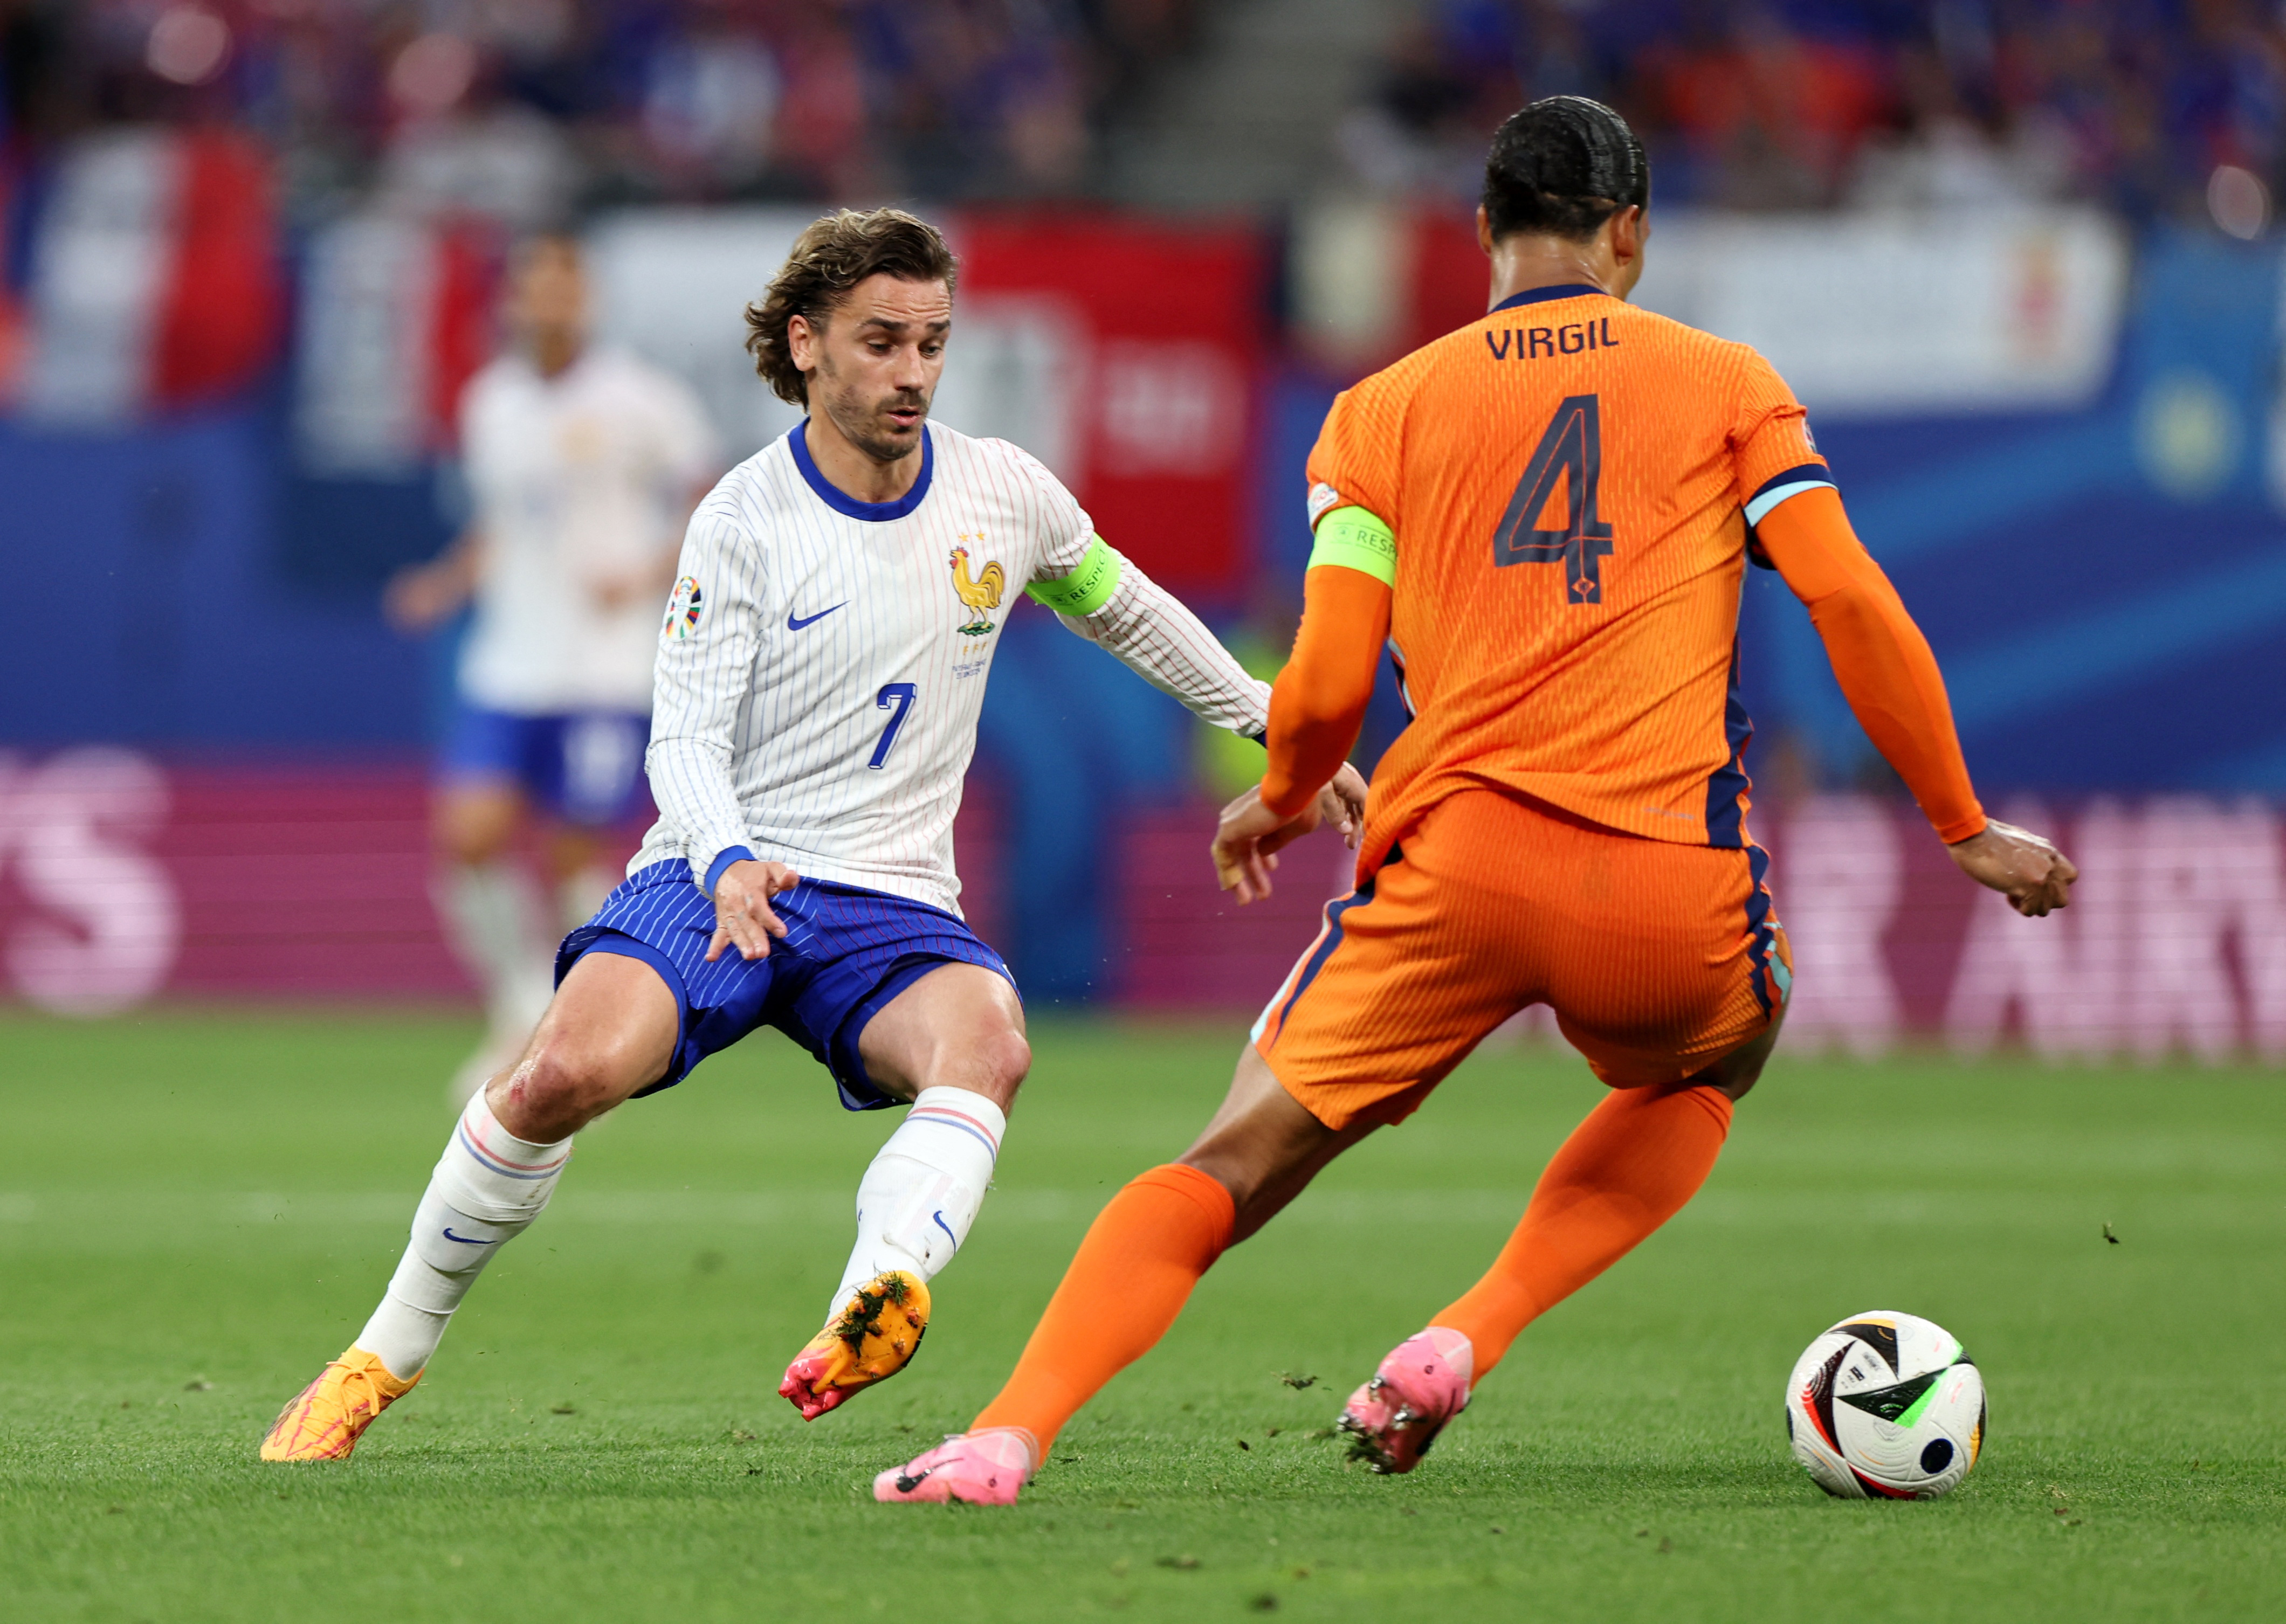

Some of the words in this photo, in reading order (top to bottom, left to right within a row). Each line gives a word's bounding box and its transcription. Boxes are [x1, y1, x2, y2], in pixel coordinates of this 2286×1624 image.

[1486, 317, 1619, 360] VIRGIL
[1493, 393, 1614, 605] 4
[1070, 548, 1106, 600] RESPECT
[867, 683, 918, 769] 7
